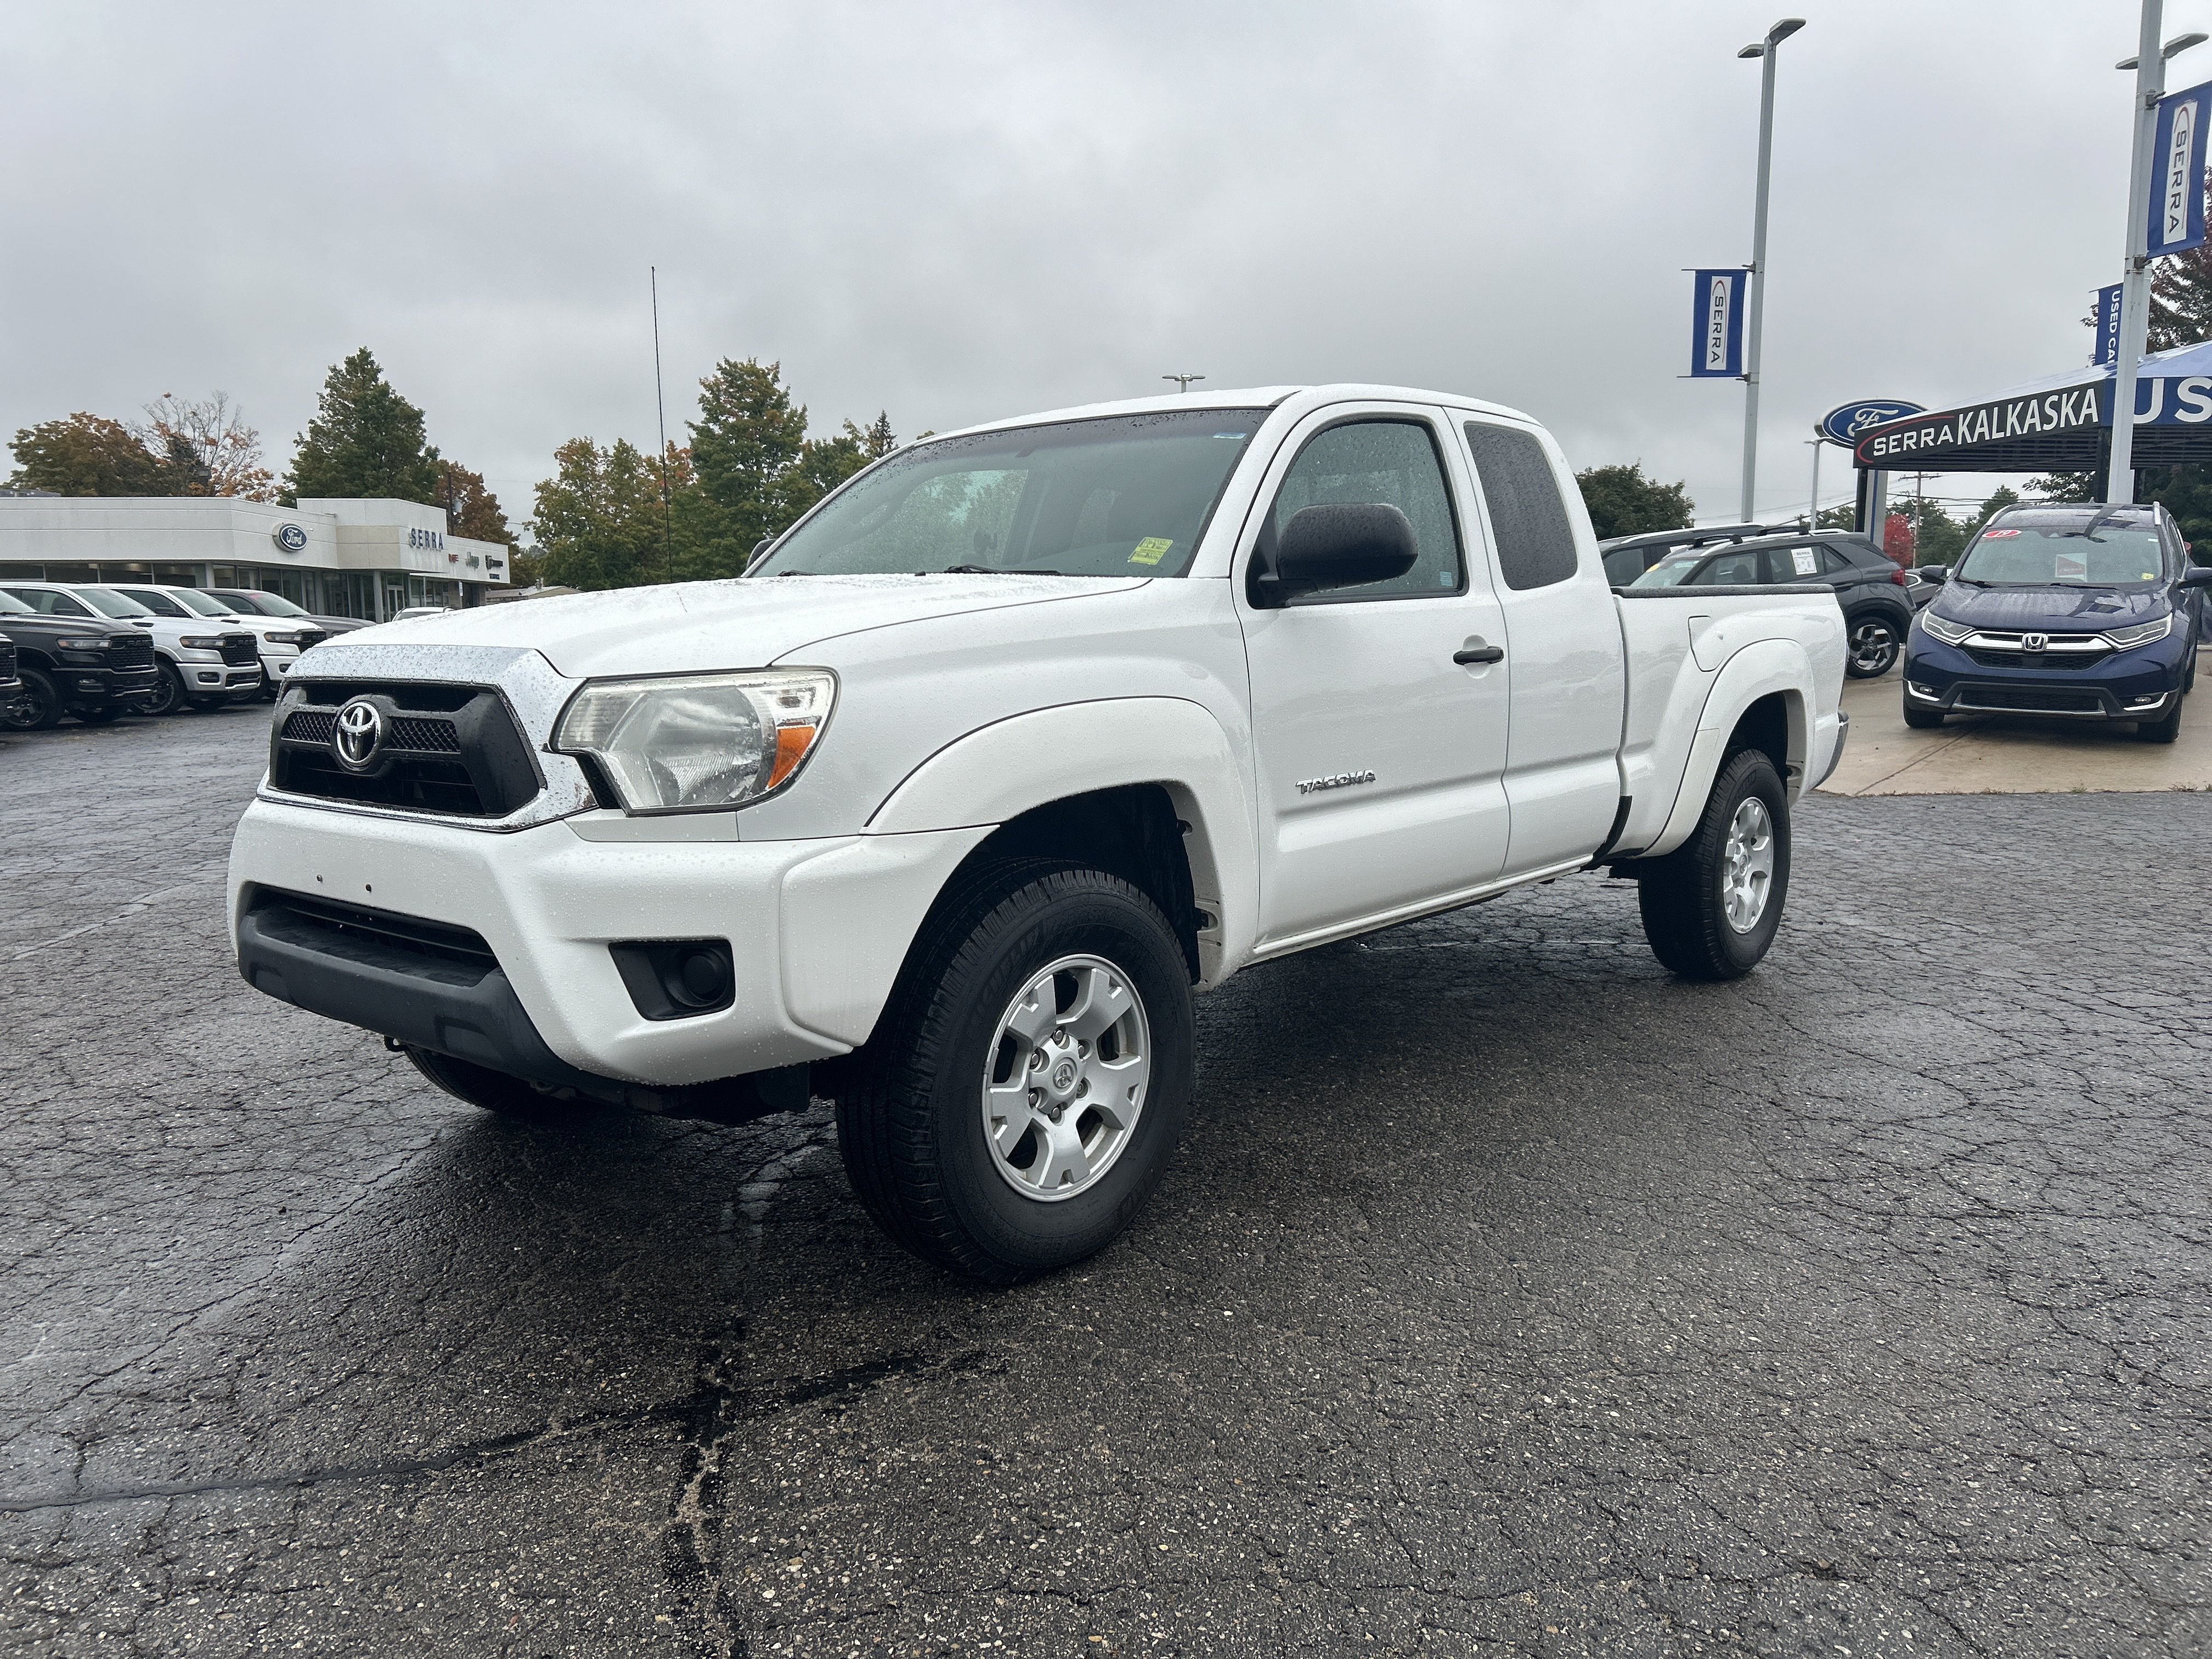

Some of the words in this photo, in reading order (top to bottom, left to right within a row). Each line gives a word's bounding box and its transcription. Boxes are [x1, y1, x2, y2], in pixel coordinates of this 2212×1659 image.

[2169, 130, 2186, 234] SERRA
[2109, 290, 2120, 333] USED
[1711, 296, 1724, 363] SERRA
[2107, 337, 2116, 363] CA
[1873, 425, 1954, 456] SERRA
[1956, 388, 2098, 445] KALKASKA
[286, 528, 303, 545] Ford
[410, 528, 443, 549] SERRA
[1295, 768, 1376, 794] TACOMA
